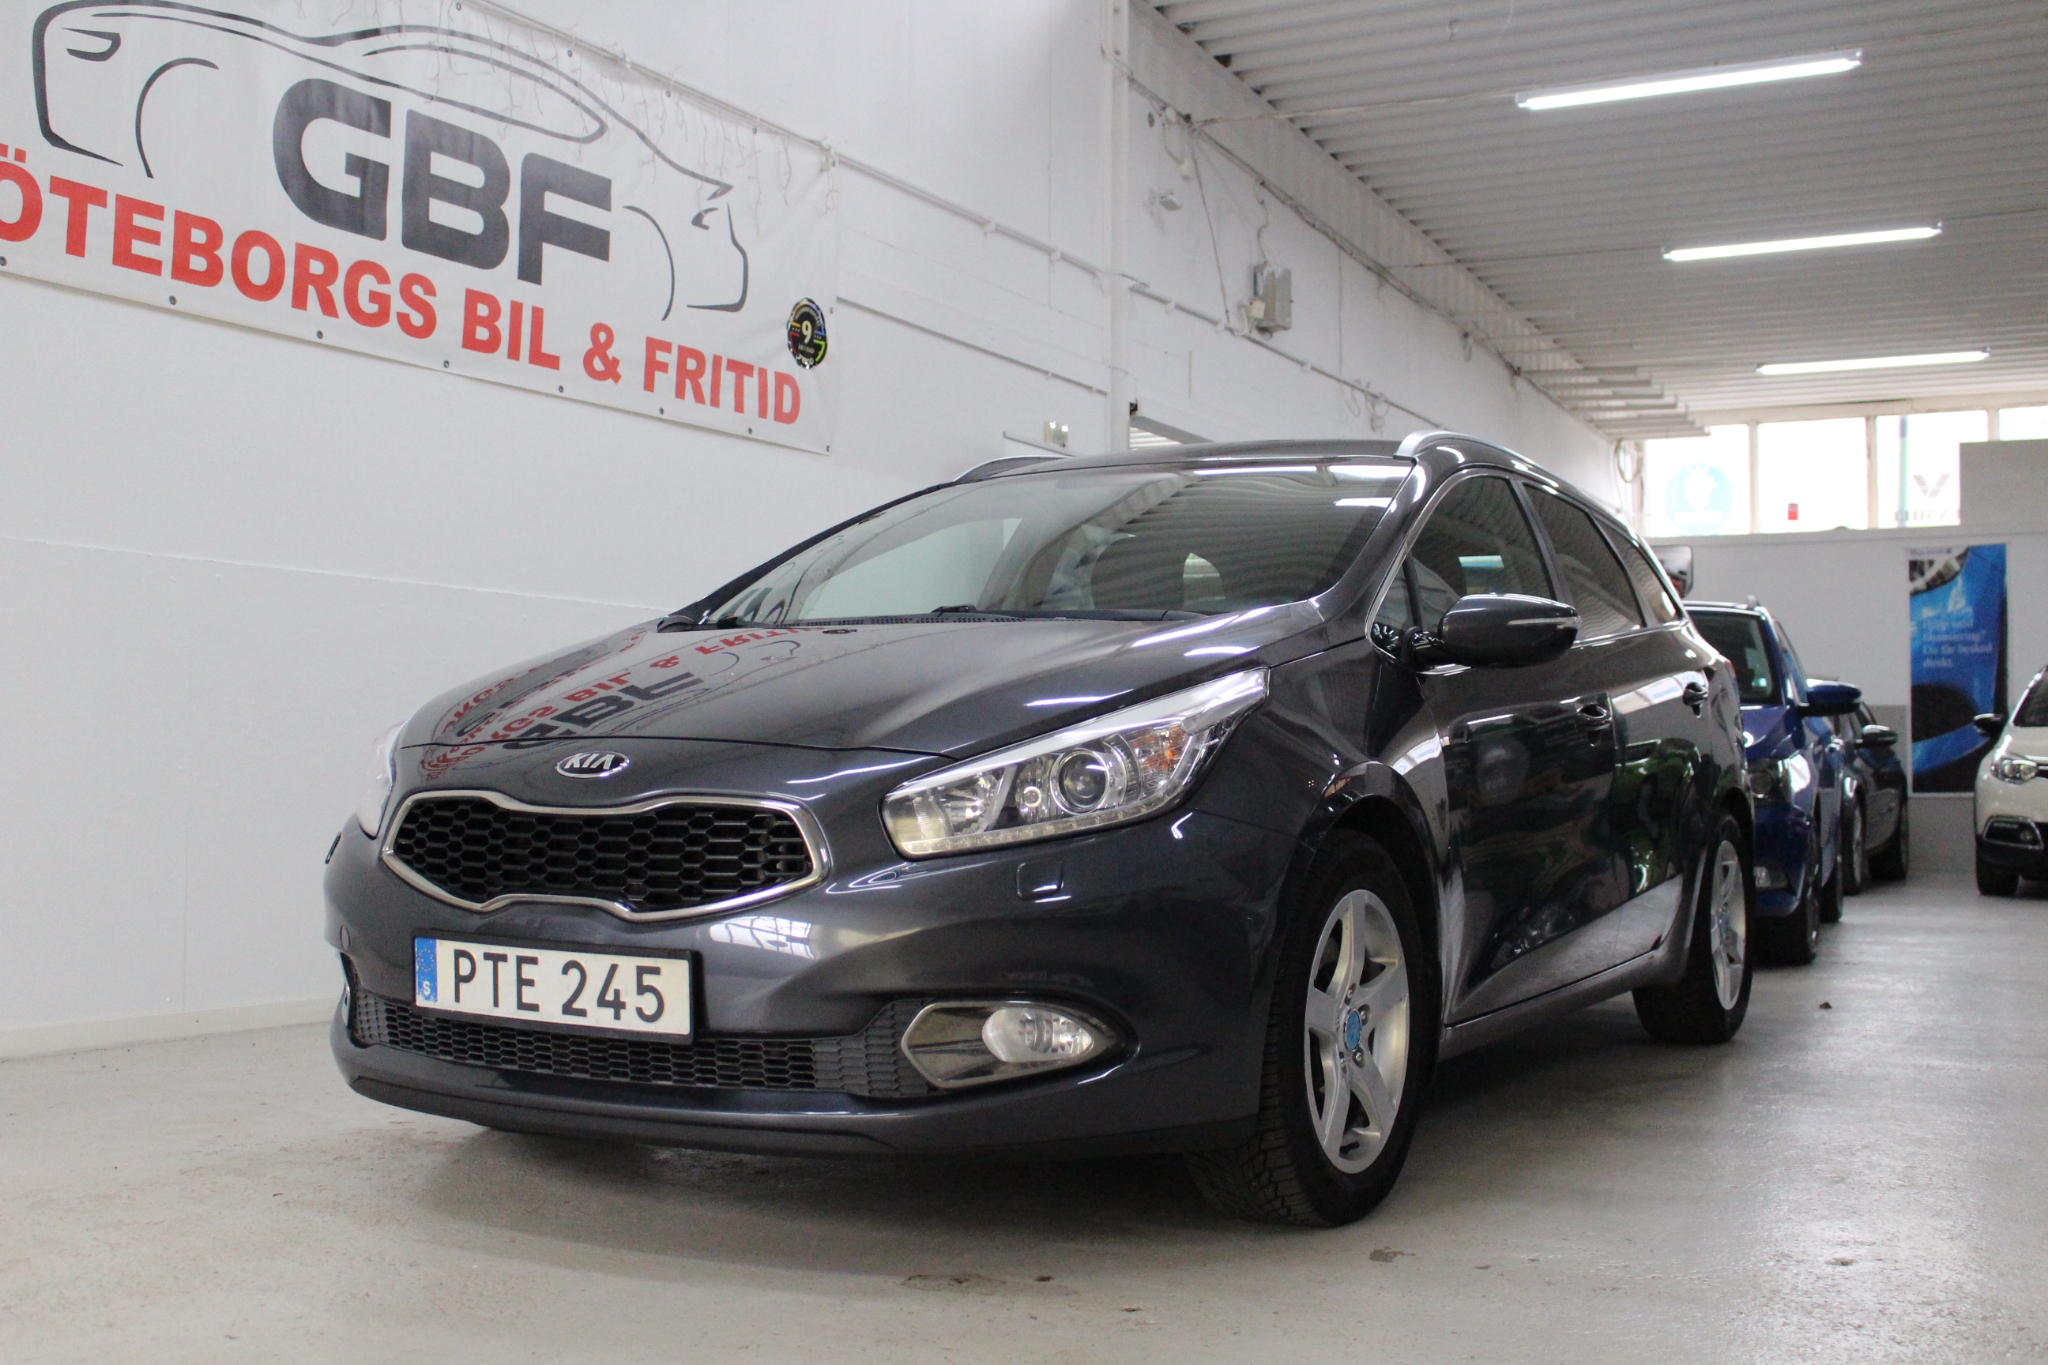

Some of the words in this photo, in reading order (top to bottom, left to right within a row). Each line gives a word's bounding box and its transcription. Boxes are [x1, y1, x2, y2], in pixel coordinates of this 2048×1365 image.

[274, 77, 612, 286] GBF
[0, 143, 438, 340] ÖTEBORGS
[461, 288, 561, 371] BIL
[583, 322, 621, 384] &
[643, 336, 801, 425] FRITID
[801, 320, 813, 344] 9
[564, 752, 616, 770] KIA
[421, 979, 432, 996] S
[453, 948, 541, 1013] PTE
[561, 959, 666, 1024] 245
